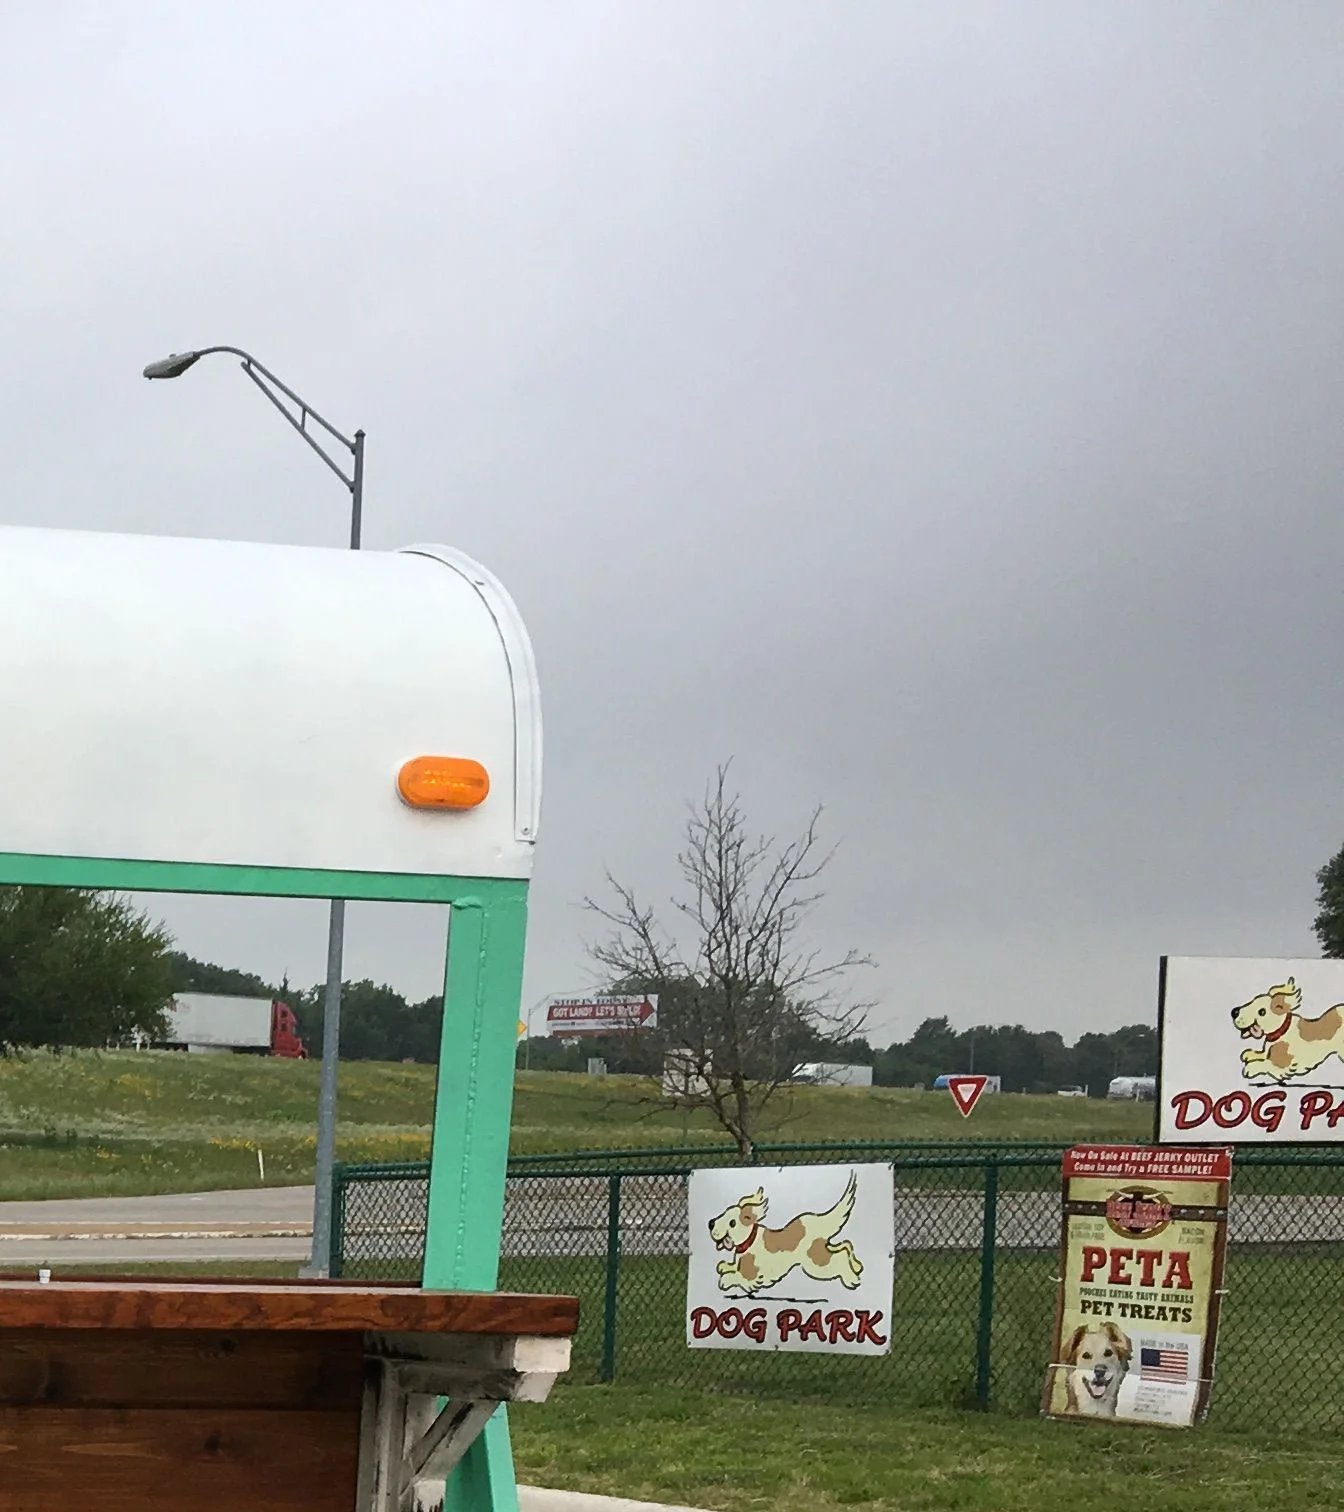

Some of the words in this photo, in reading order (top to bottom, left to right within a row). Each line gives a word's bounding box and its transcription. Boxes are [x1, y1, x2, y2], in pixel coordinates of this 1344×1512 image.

[553, 1007, 568, 1017] GOT
[570, 1006, 592, 1017] LAND?
[1171, 1090, 1287, 1133] DOG
[1074, 1161, 1096, 1171] Come
[1107, 1163, 1123, 1173] and
[1124, 1164, 1137, 1174] Try
[1147, 1164, 1170, 1174] FREE
[1172, 1165, 1213, 1175] SAMPLE!
[1131, 1152, 1153, 1161] BEEF
[1154, 1152, 1183, 1162] JERKY
[1184, 1153, 1220, 1163] OUTLET
[1080, 1246, 1193, 1289] PETA
[1079, 1286, 1107, 1298] POOCHES
[1109, 1288, 1134, 1300] EATING
[1136, 1291, 1159, 1302] TASTY
[1161, 1293, 1194, 1304] ANIMALS
[1080, 1299, 1114, 1316] PET
[1118, 1302, 1193, 1323] TREATS
[690, 1306, 768, 1343] DOG
[776, 1308, 888, 1345] PARK
